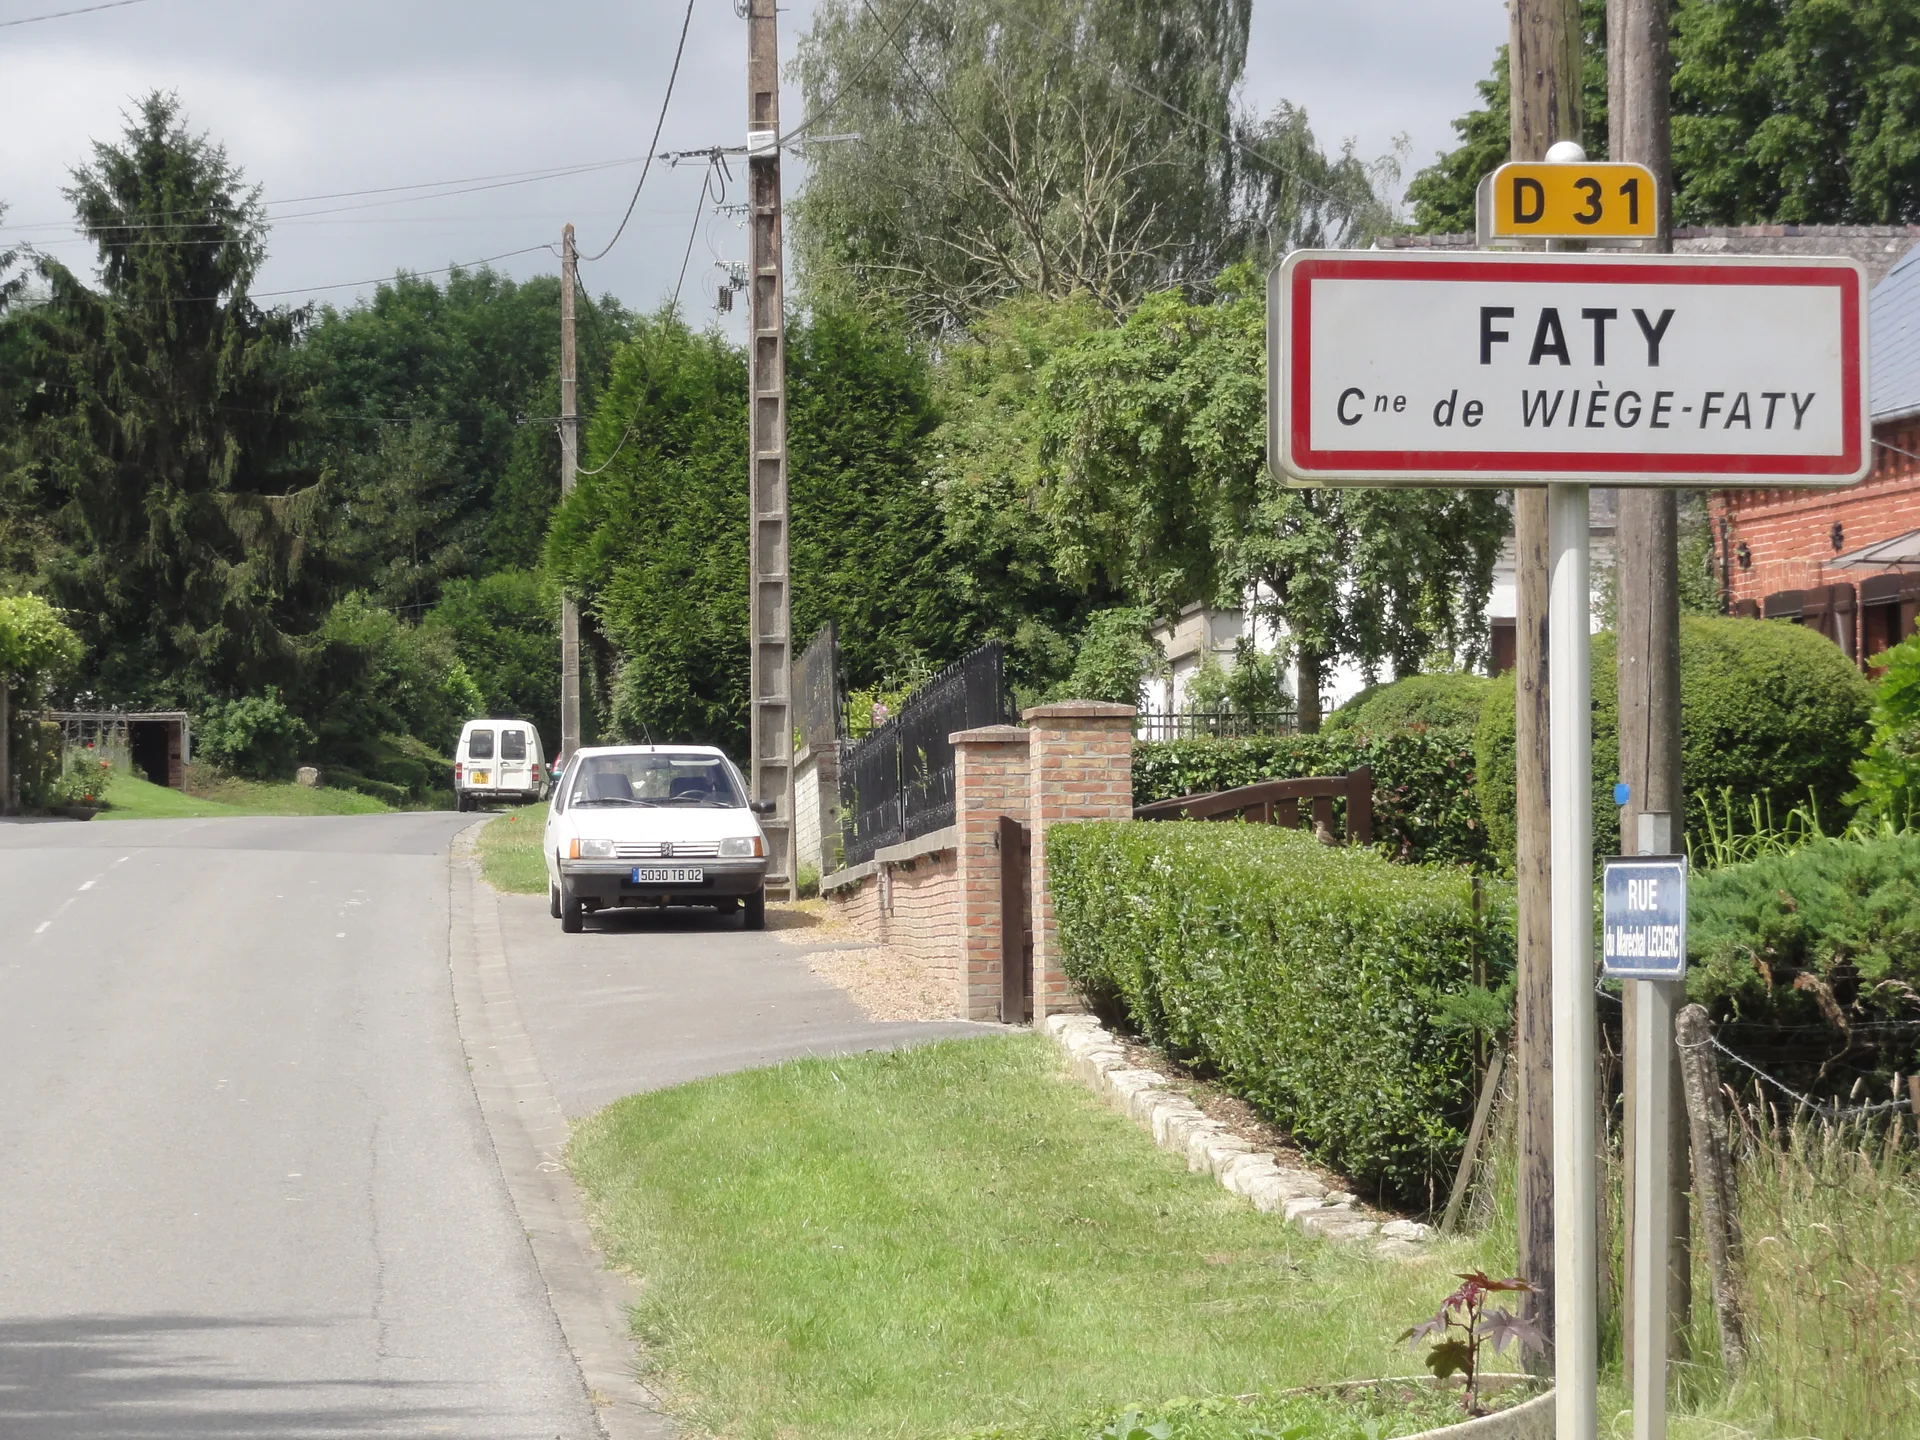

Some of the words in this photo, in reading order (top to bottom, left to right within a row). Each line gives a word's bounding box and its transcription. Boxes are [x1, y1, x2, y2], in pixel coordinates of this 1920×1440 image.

[1513, 178, 1545, 224] D
[1572, 178, 1639, 225] 31
[1479, 306, 1676, 367] FATY
[1337, 387, 1407, 426] Cne
[1432, 389, 1484, 428] de
[1521, 381, 1816, 431] WIÈGE-FATY
[641, 869, 668, 881] 5030
[672, 869, 685, 881] TB
[688, 869, 701, 881] 02
[1628, 879, 1658, 911] RUE
[1606, 926, 1615, 957] du
[1616, 925, 1646, 957] Maréchal
[1647, 925, 1679, 958] LECLERC
